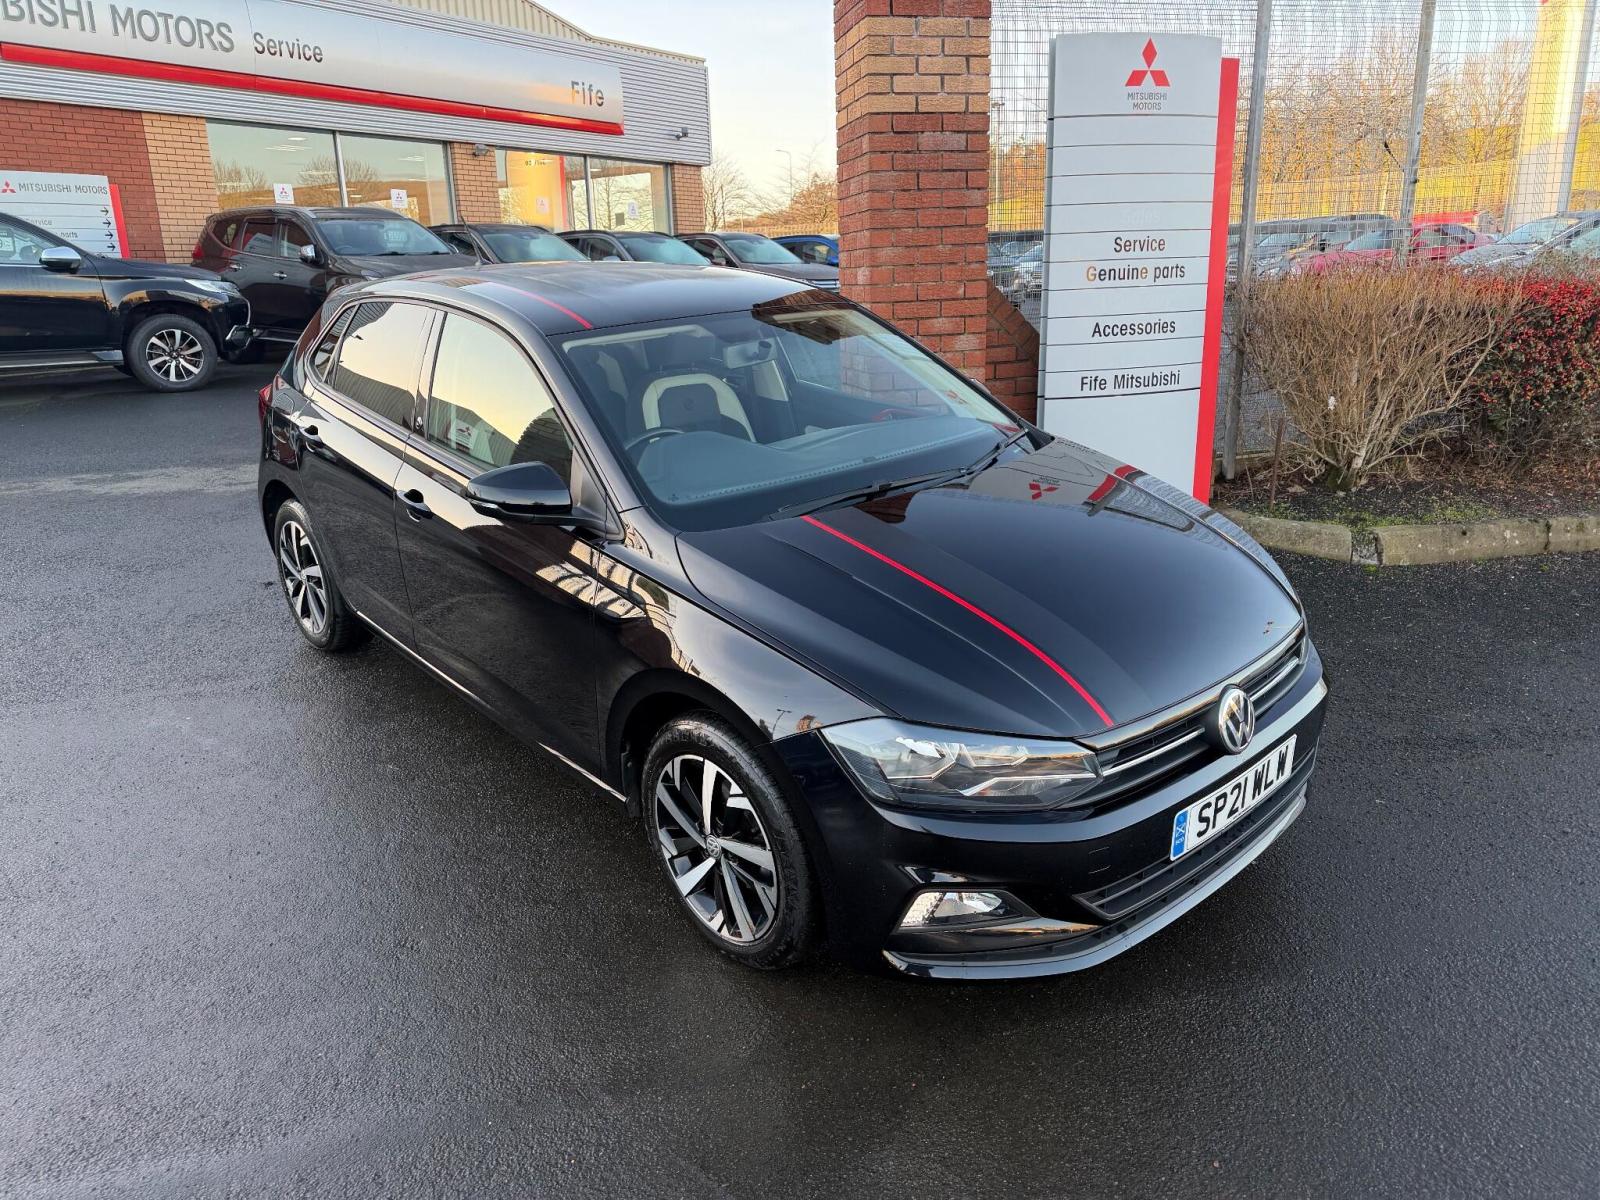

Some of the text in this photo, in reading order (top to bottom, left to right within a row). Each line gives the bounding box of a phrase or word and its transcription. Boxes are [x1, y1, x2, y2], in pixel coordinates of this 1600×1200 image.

[109, 3, 235, 53] MOTORS
[253, 32, 324, 64] Service
[571, 80, 605, 107] Fife
[1127, 92, 1168, 101] MITSUBISHI
[1132, 102, 1162, 111] MOTORS
[18, 182, 108, 195] MITSUBISHI MOTORS
[1113, 236, 1166, 253] Service
[1086, 263, 1186, 283] Genuine parts
[1091, 319, 1176, 338] Accessories
[1080, 370, 1181, 392] Fife Mitsubishi
[1196, 776, 1248, 838] SP21
